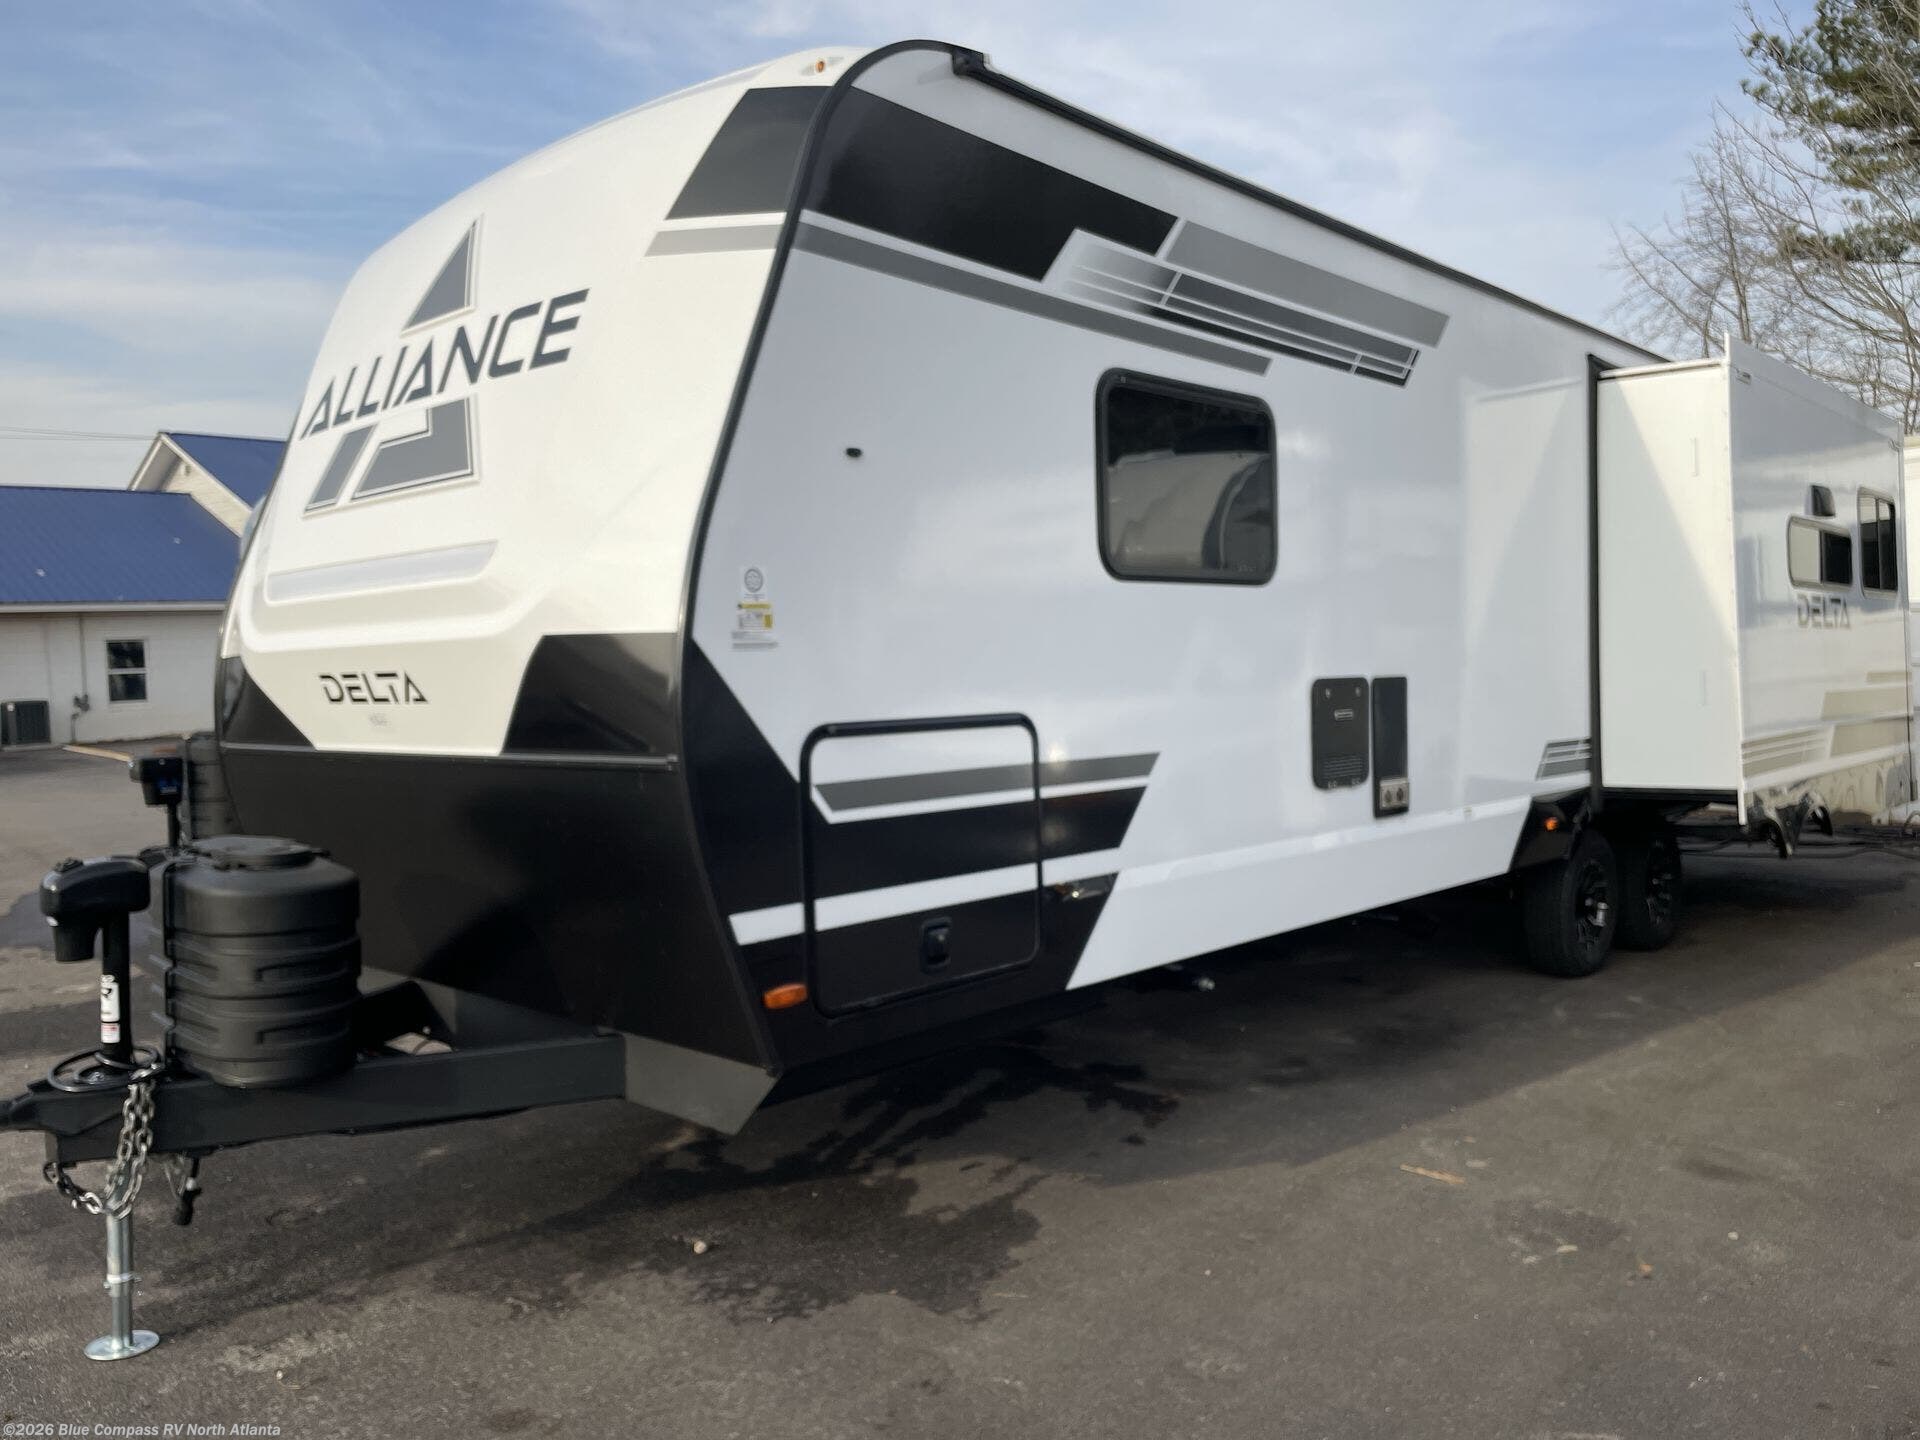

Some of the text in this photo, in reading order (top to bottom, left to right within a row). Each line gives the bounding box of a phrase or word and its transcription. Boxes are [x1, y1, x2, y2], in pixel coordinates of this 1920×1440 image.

[300, 287, 590, 440] ALLIANCE
[1797, 594, 1850, 629] DELTA
[319, 671, 428, 703] DELTA
